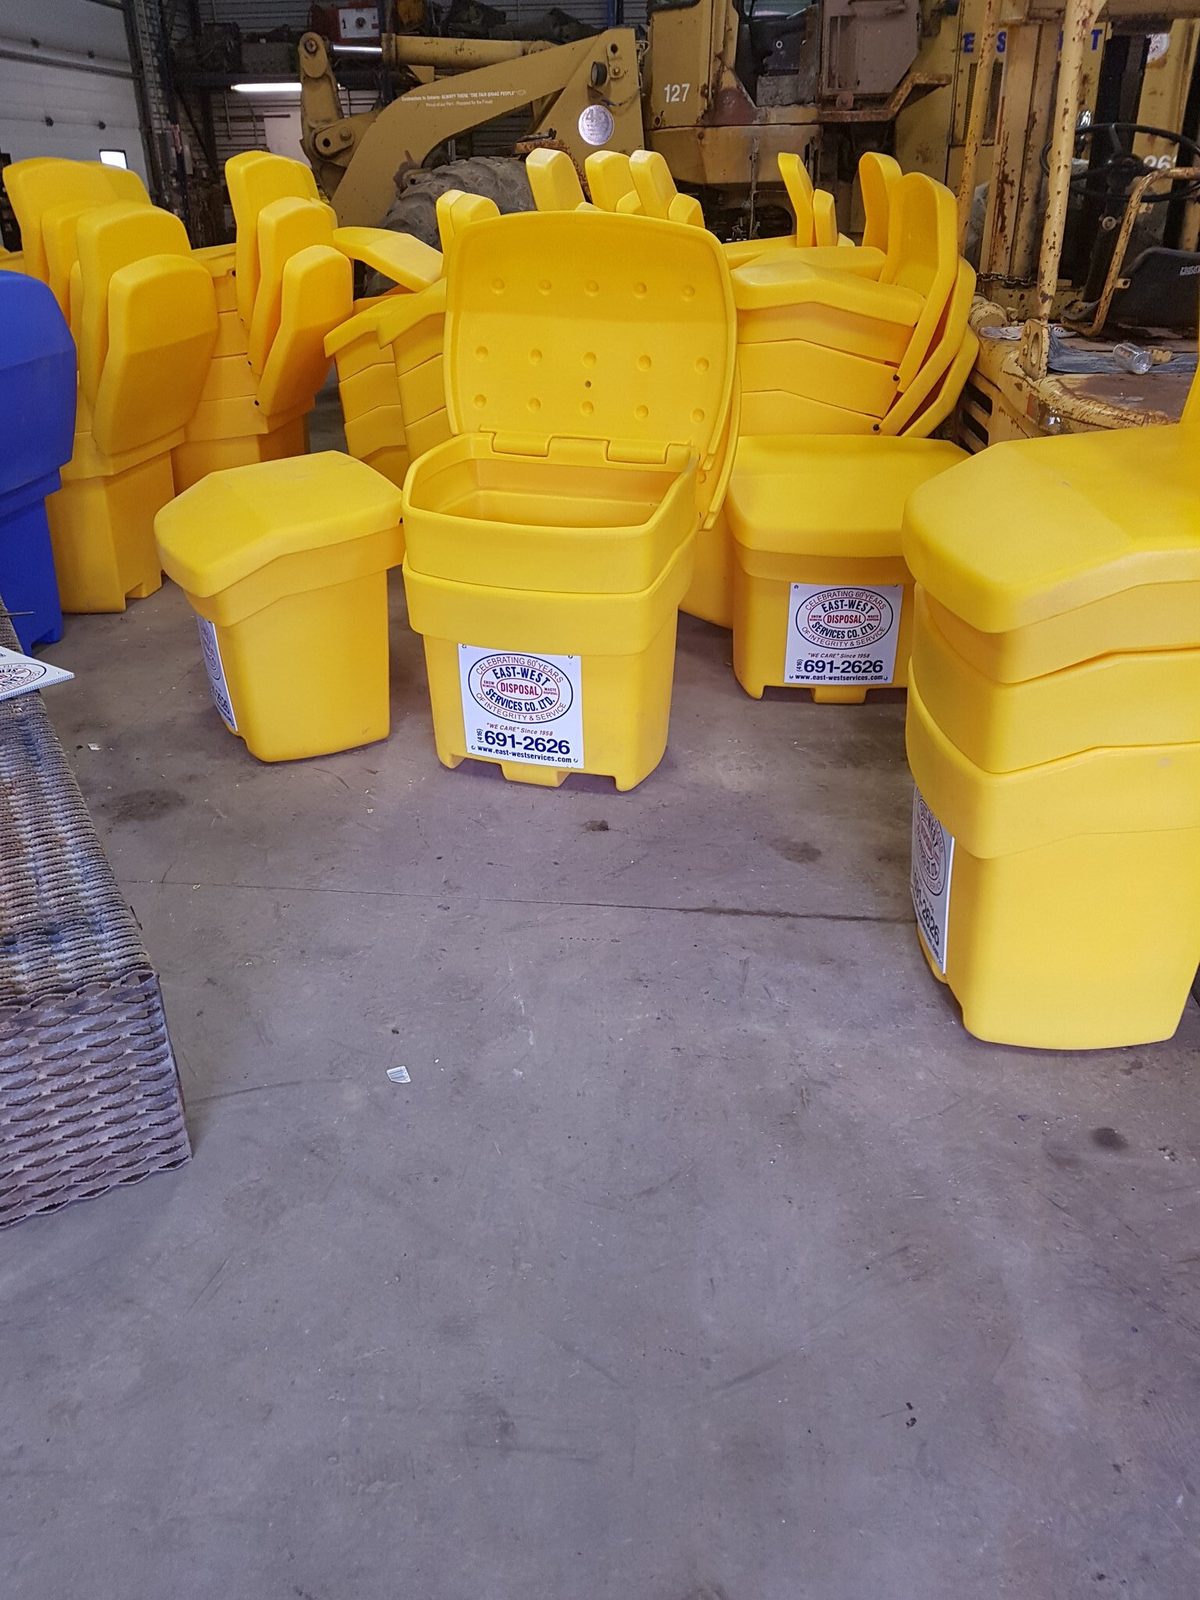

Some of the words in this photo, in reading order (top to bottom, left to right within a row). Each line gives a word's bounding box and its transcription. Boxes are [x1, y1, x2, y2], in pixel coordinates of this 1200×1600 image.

[664, 83, 690, 103] 127
[805, 591, 854, 610] CELEBRATING
[865, 592, 886, 610] YEARS
[821, 599, 875, 615] EAST-WEST
[826, 615, 862, 624] DISPOSAL
[801, 626, 810, 637] OF
[809, 633, 848, 647] INTEGRITY
[856, 626, 886, 646] SERVICE
[811, 622, 845, 640] SERVICES
[846, 629, 860, 640] CO.
[861, 622, 876, 635] LTD.
[475, 656, 526, 676] CELEBRATING
[538, 661, 564, 684] YEARS
[804, 660, 884, 674] 691-2626
[492, 666, 551, 687] EAST-WEST
[795, 674, 884, 682] www.east-westservices.com
[500, 682, 539, 696] DISPOSAL
[475, 692, 485, 705] OF
[485, 701, 528, 721] INTEGRITY
[535, 702, 567, 722] SERVICE
[486, 688, 523, 712] SERVICES
[524, 702, 539, 712] CO.
[538, 696, 555, 711] LTD.
[499, 724, 520, 732] CARE"
[520, 727, 538, 735] Since
[484, 730, 571, 755] 691-2626
[477, 745, 572, 763] www.east-westservices.com
